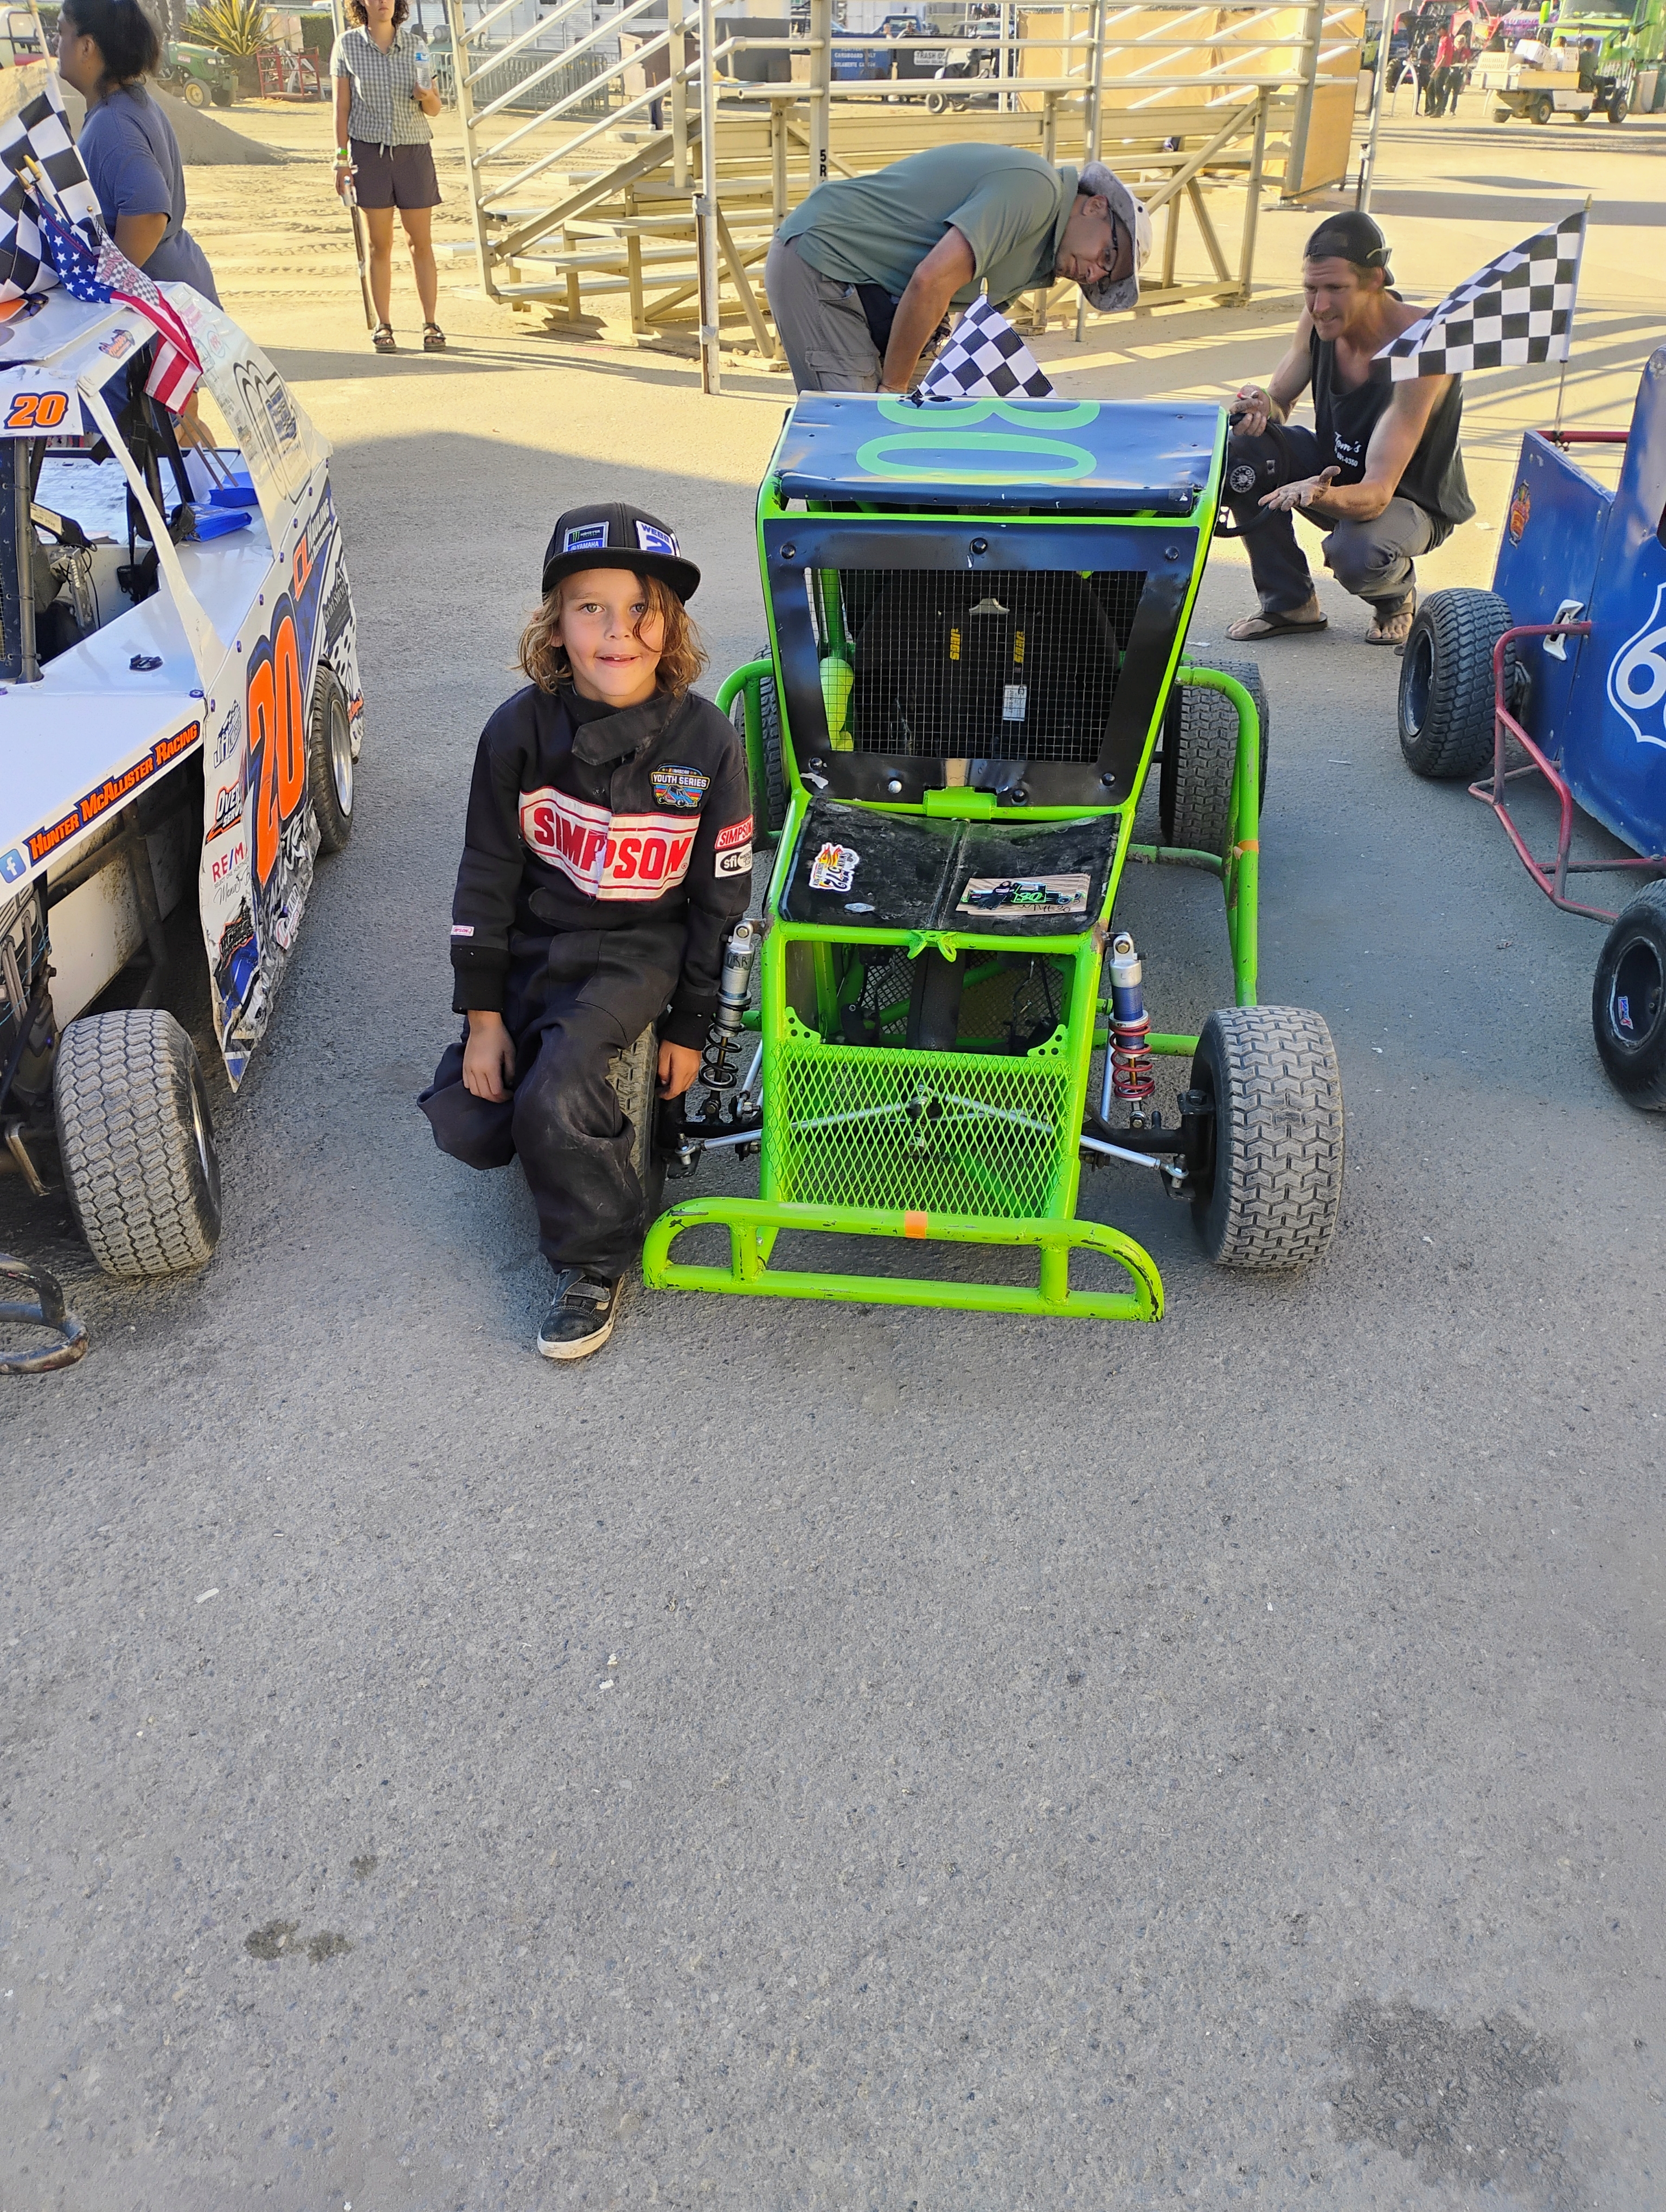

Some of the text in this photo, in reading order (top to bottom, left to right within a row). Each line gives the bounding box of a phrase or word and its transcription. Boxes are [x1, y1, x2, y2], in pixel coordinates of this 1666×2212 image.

[4, 391, 68, 428] 20
[1334, 431, 1362, 453] Tom's
[640, 523, 670, 543] WEBB
[575, 541, 599, 550] YAMAHA
[645, 534, 673, 555] 2
[248, 614, 305, 891] 20
[29, 813, 80, 861] HUNTER
[155, 723, 198, 766] RACING
[653, 774, 707, 788] YOUTH SERIES
[534, 807, 693, 880] SIMPSON
[719, 821, 752, 846] SIMPSON
[723, 854, 738, 869] sfi
